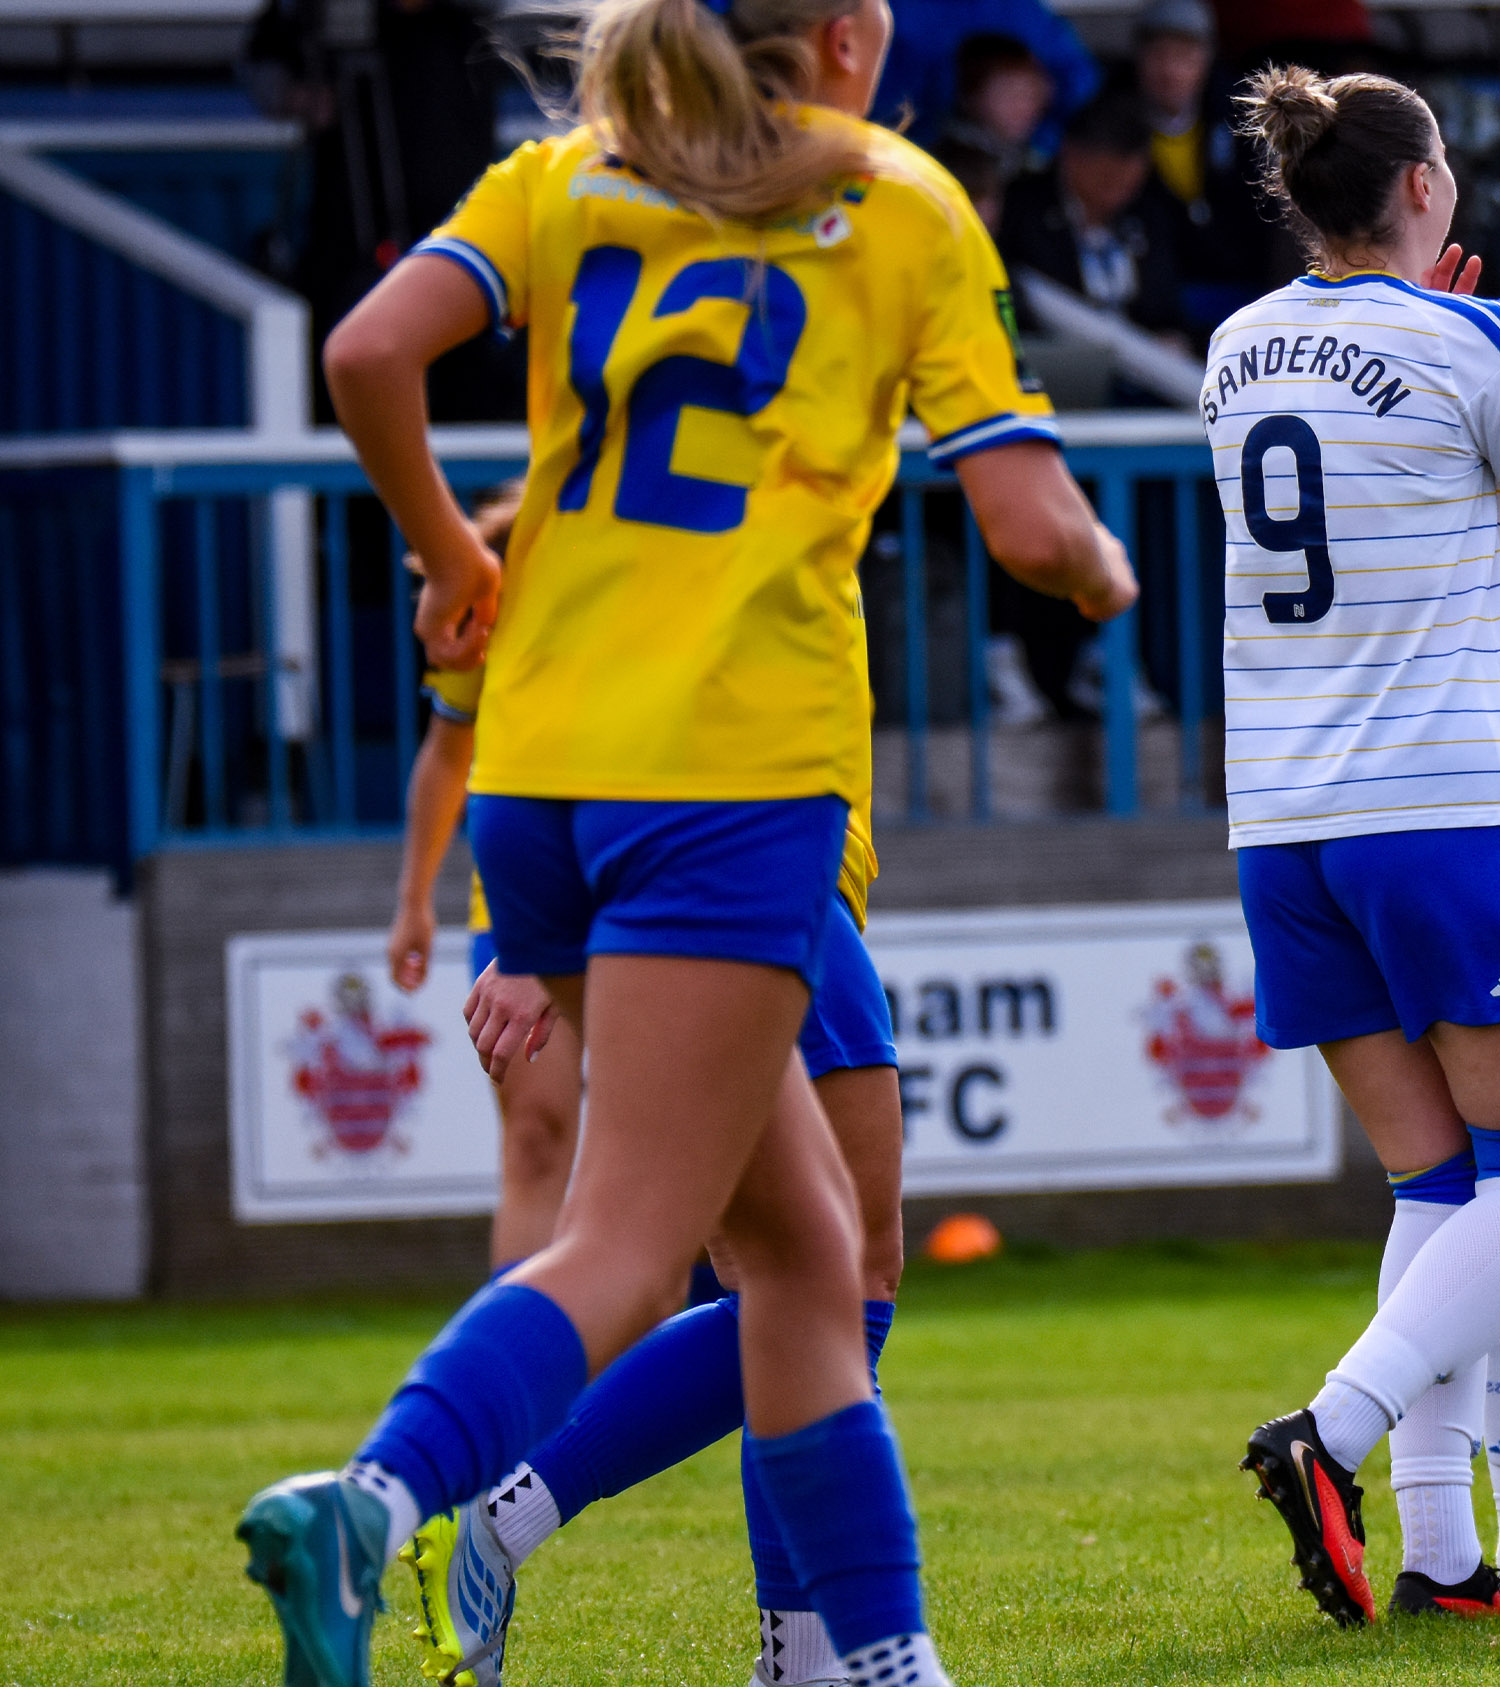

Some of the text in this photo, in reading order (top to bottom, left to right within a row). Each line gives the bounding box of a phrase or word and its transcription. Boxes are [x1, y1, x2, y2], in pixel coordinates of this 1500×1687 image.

[556, 244, 809, 536] 12
[1203, 335, 1412, 425] SANDERSON
[1240, 414, 1335, 625] 9
